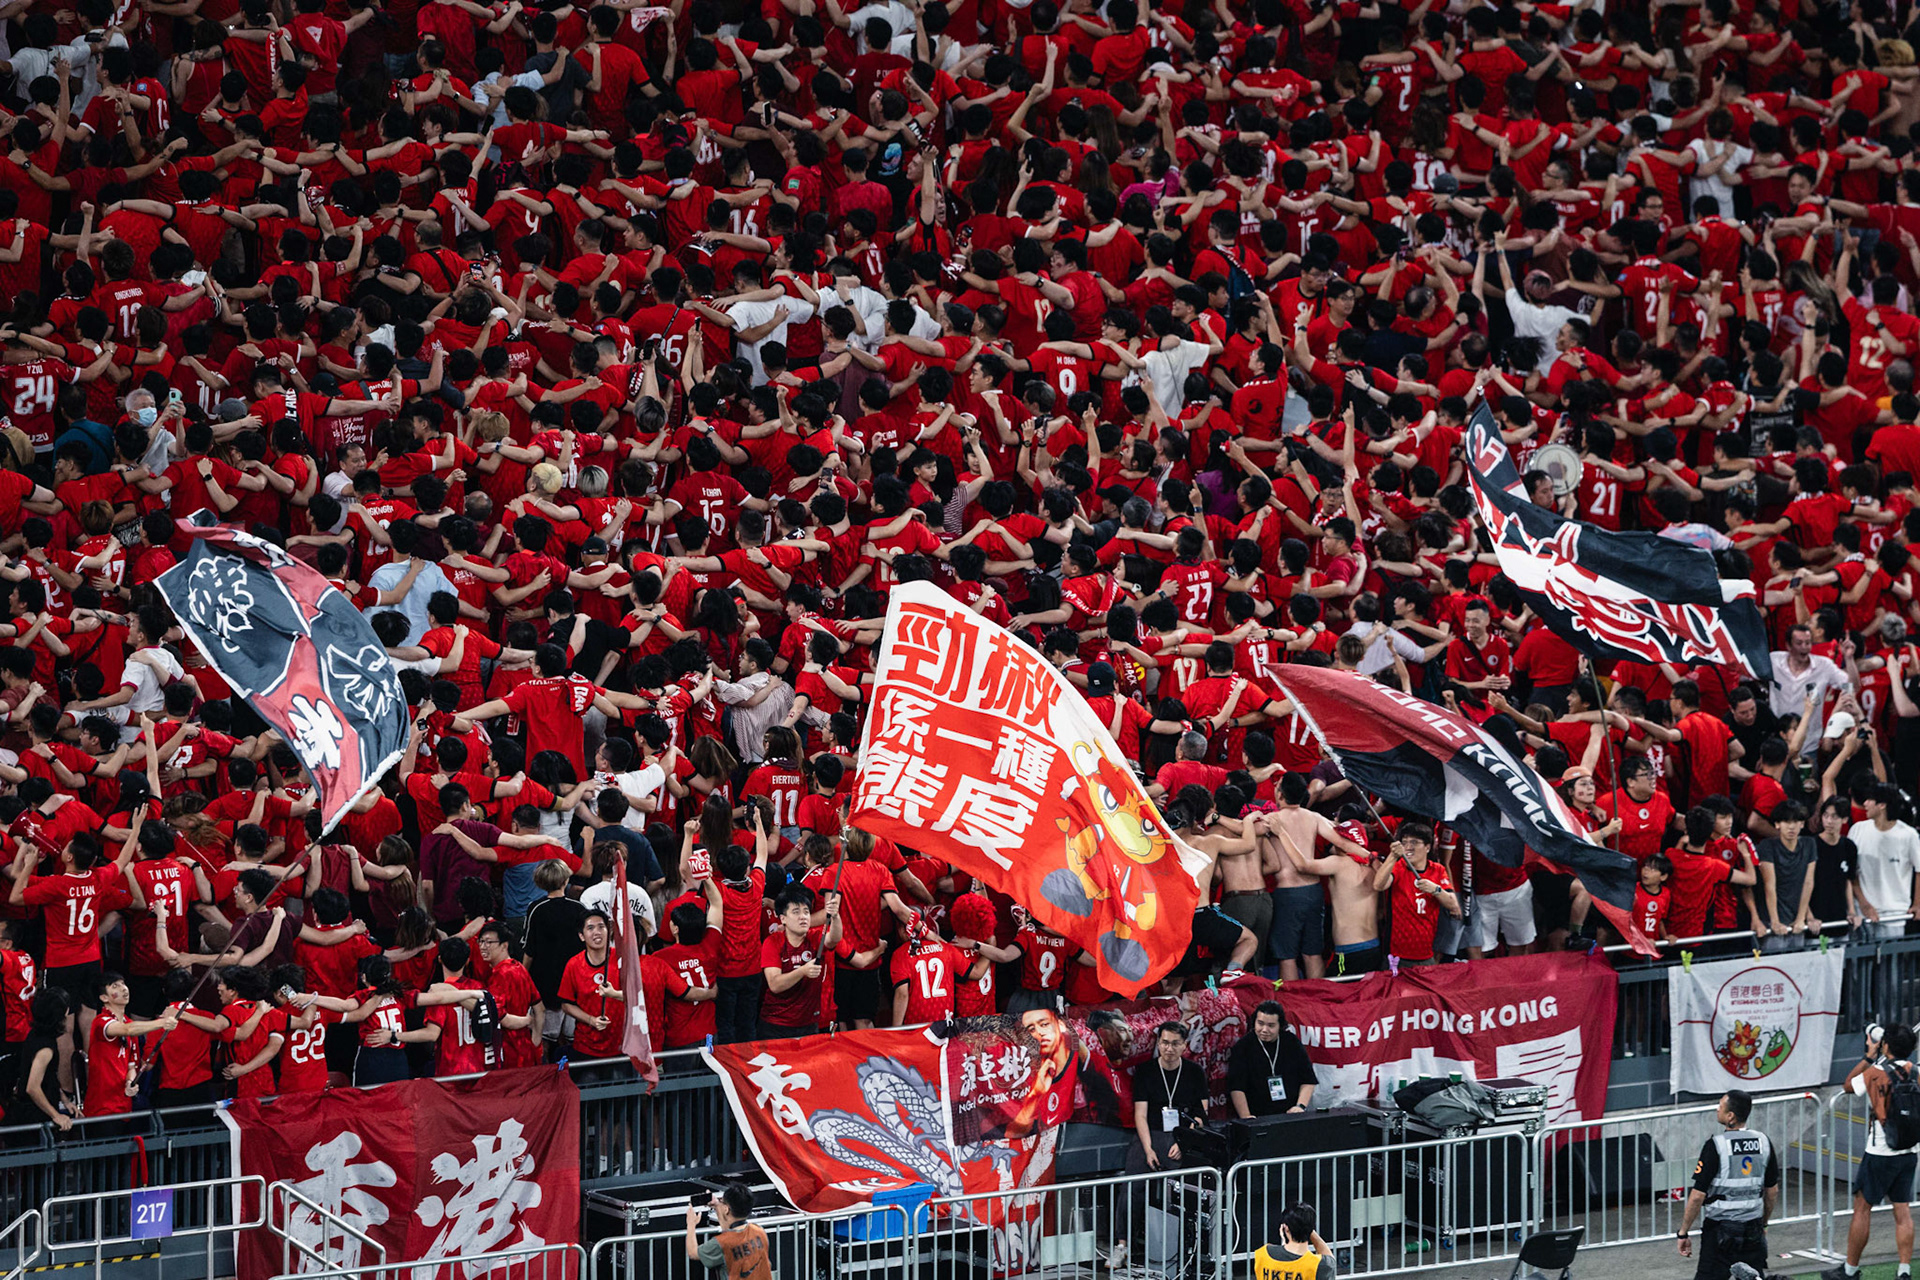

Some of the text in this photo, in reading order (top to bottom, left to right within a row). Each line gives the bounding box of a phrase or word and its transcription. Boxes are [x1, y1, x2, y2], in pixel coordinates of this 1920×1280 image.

[729, 208, 761, 238] 16
[1859, 336, 1886, 369] 12
[14, 376, 54, 415] 24
[1588, 481, 1617, 516] 21
[887, 602, 1063, 739] 勁揪
[1173, 657, 1200, 687] 12
[1861, 688, 1877, 724] 9
[877, 689, 1059, 797] 係一種
[771, 774, 801, 787] EVERTON
[771, 789, 801, 827] 11
[854, 741, 1040, 872] 態度
[69, 885, 96, 898] C L TAN
[148, 874, 154, 885] T
[162, 869, 181, 883] YUE
[66, 897, 96, 936] 16
[152, 880, 184, 917] 21
[1644, 917, 1657, 933] 12
[915, 958, 948, 1000] 12
[1038, 950, 1057, 988] 9
[1366, 1014, 1396, 1043] OF
[1401, 1007, 1474, 1035] HONG
[1479, 995, 1559, 1032] KONG
[290, 1022, 326, 1065] 22
[1733, 1138, 1760, 1152] A 200
[136, 1201, 168, 1225] 217
